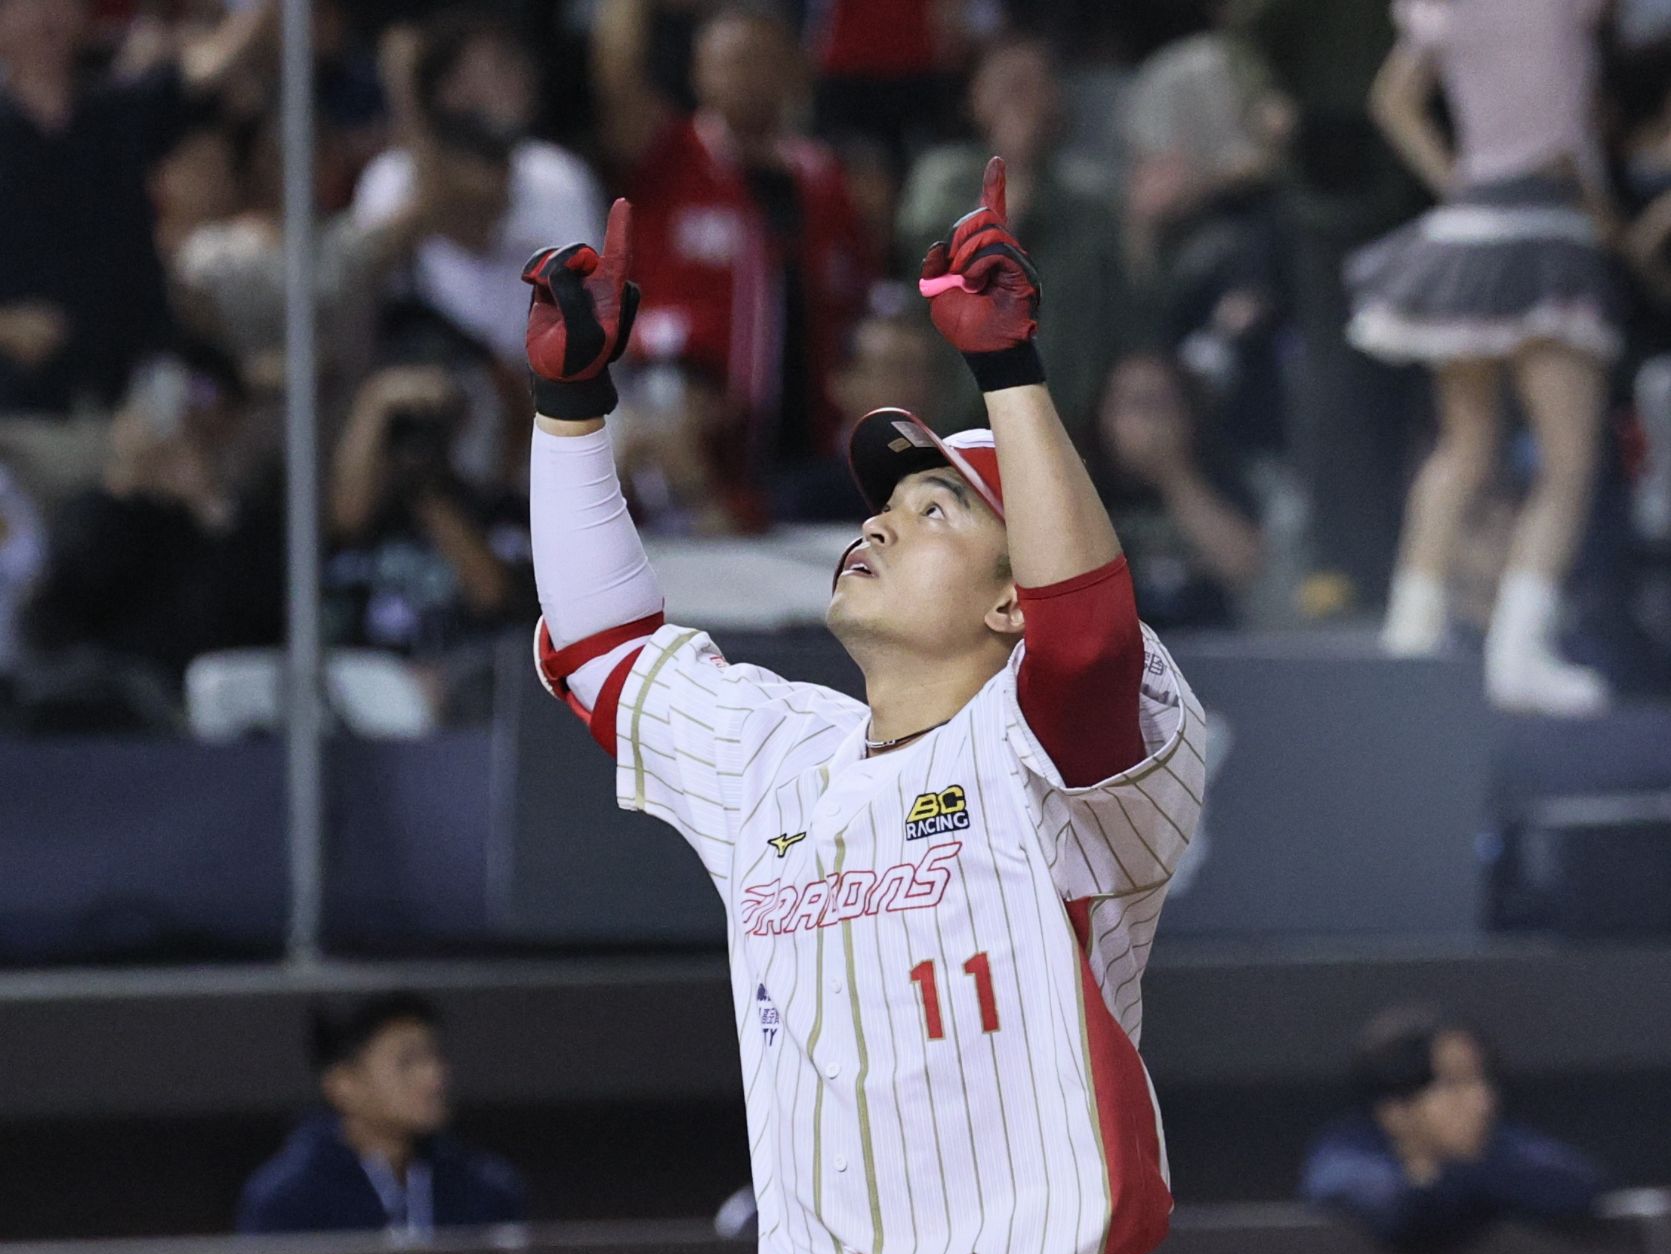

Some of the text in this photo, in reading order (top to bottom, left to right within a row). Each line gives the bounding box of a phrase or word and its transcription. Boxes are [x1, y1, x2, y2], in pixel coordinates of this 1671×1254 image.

[907, 785, 967, 822] BC
[906, 813, 969, 839] RACING
[909, 951, 1001, 1042] 11
